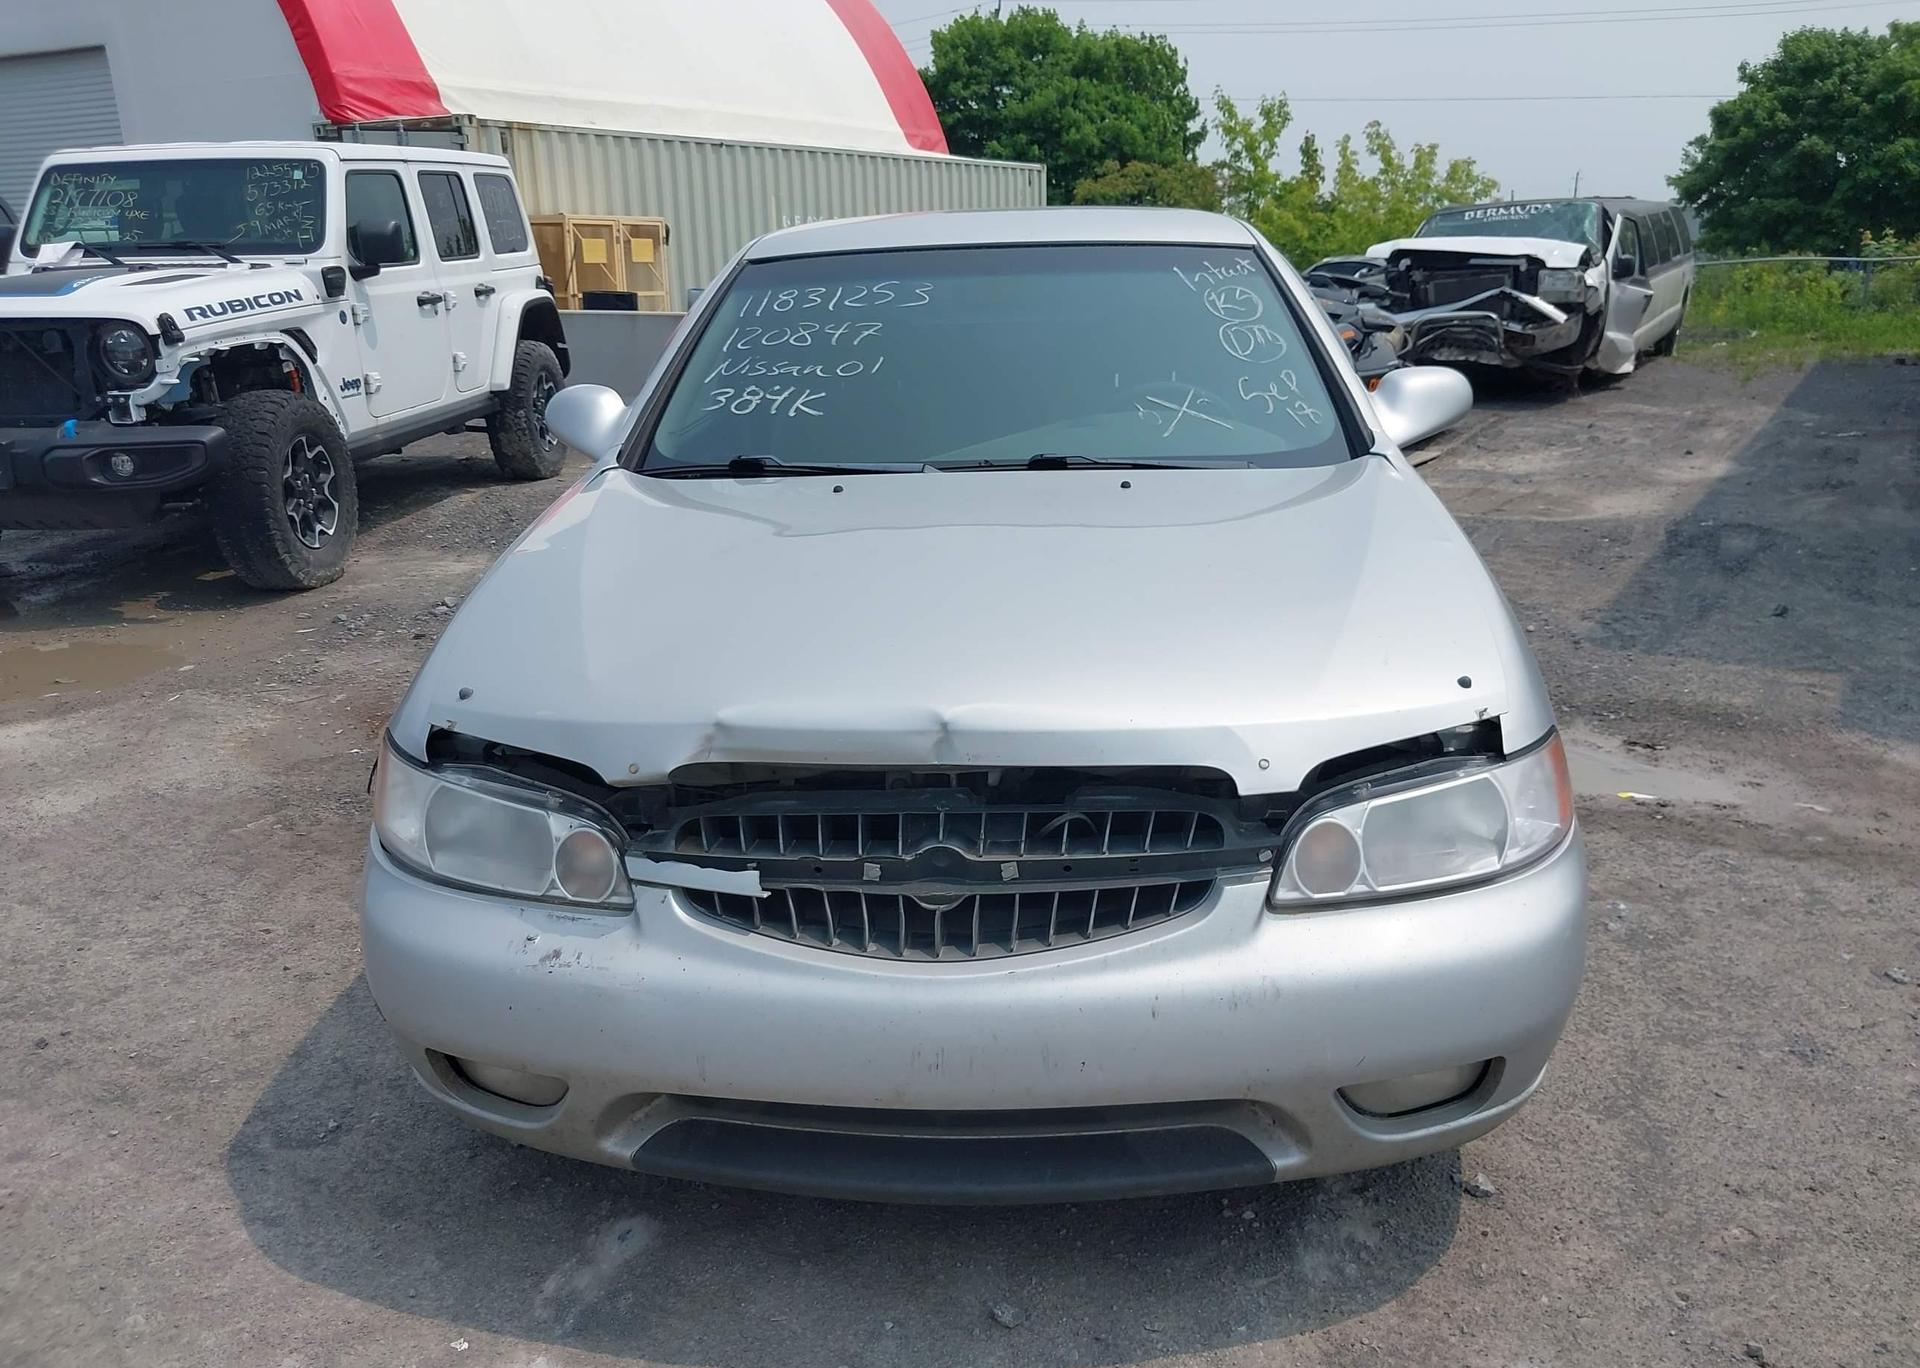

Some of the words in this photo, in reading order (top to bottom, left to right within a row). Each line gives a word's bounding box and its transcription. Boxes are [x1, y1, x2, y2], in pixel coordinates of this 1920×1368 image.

[1464, 203, 1554, 221] BERMUDA
[183, 288, 305, 322] RUBICON
[739, 280, 935, 318] 11831253
[722, 321, 884, 353] 120847
[339, 376, 362, 393] Jeep
[703, 355, 833, 384] Nissan
[701, 384, 827, 417] 384K
